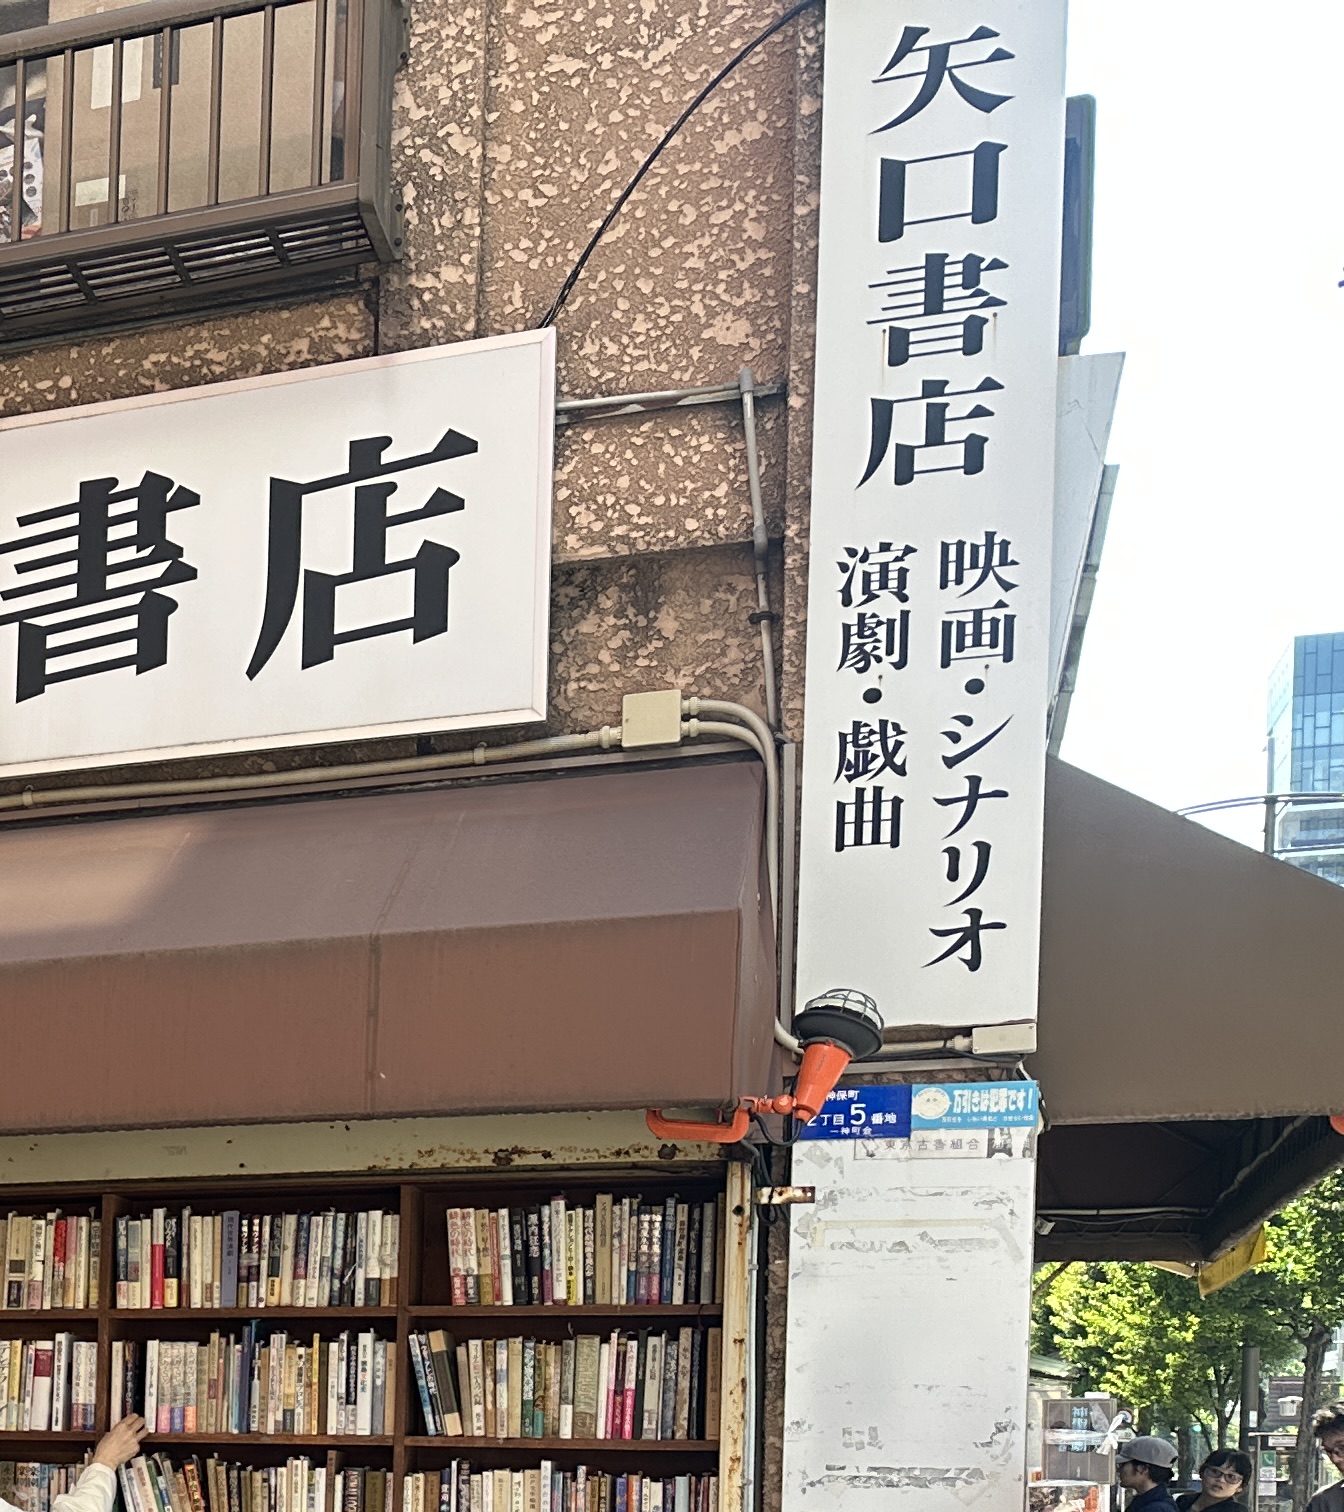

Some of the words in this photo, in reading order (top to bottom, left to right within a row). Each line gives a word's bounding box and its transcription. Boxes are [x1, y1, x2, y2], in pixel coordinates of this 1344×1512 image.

[856, 25, 1015, 489] 矢口書店
[834, 541, 917, 853] 演劇・戯曲
[923, 530, 1020, 973] 映画・シナリオ
